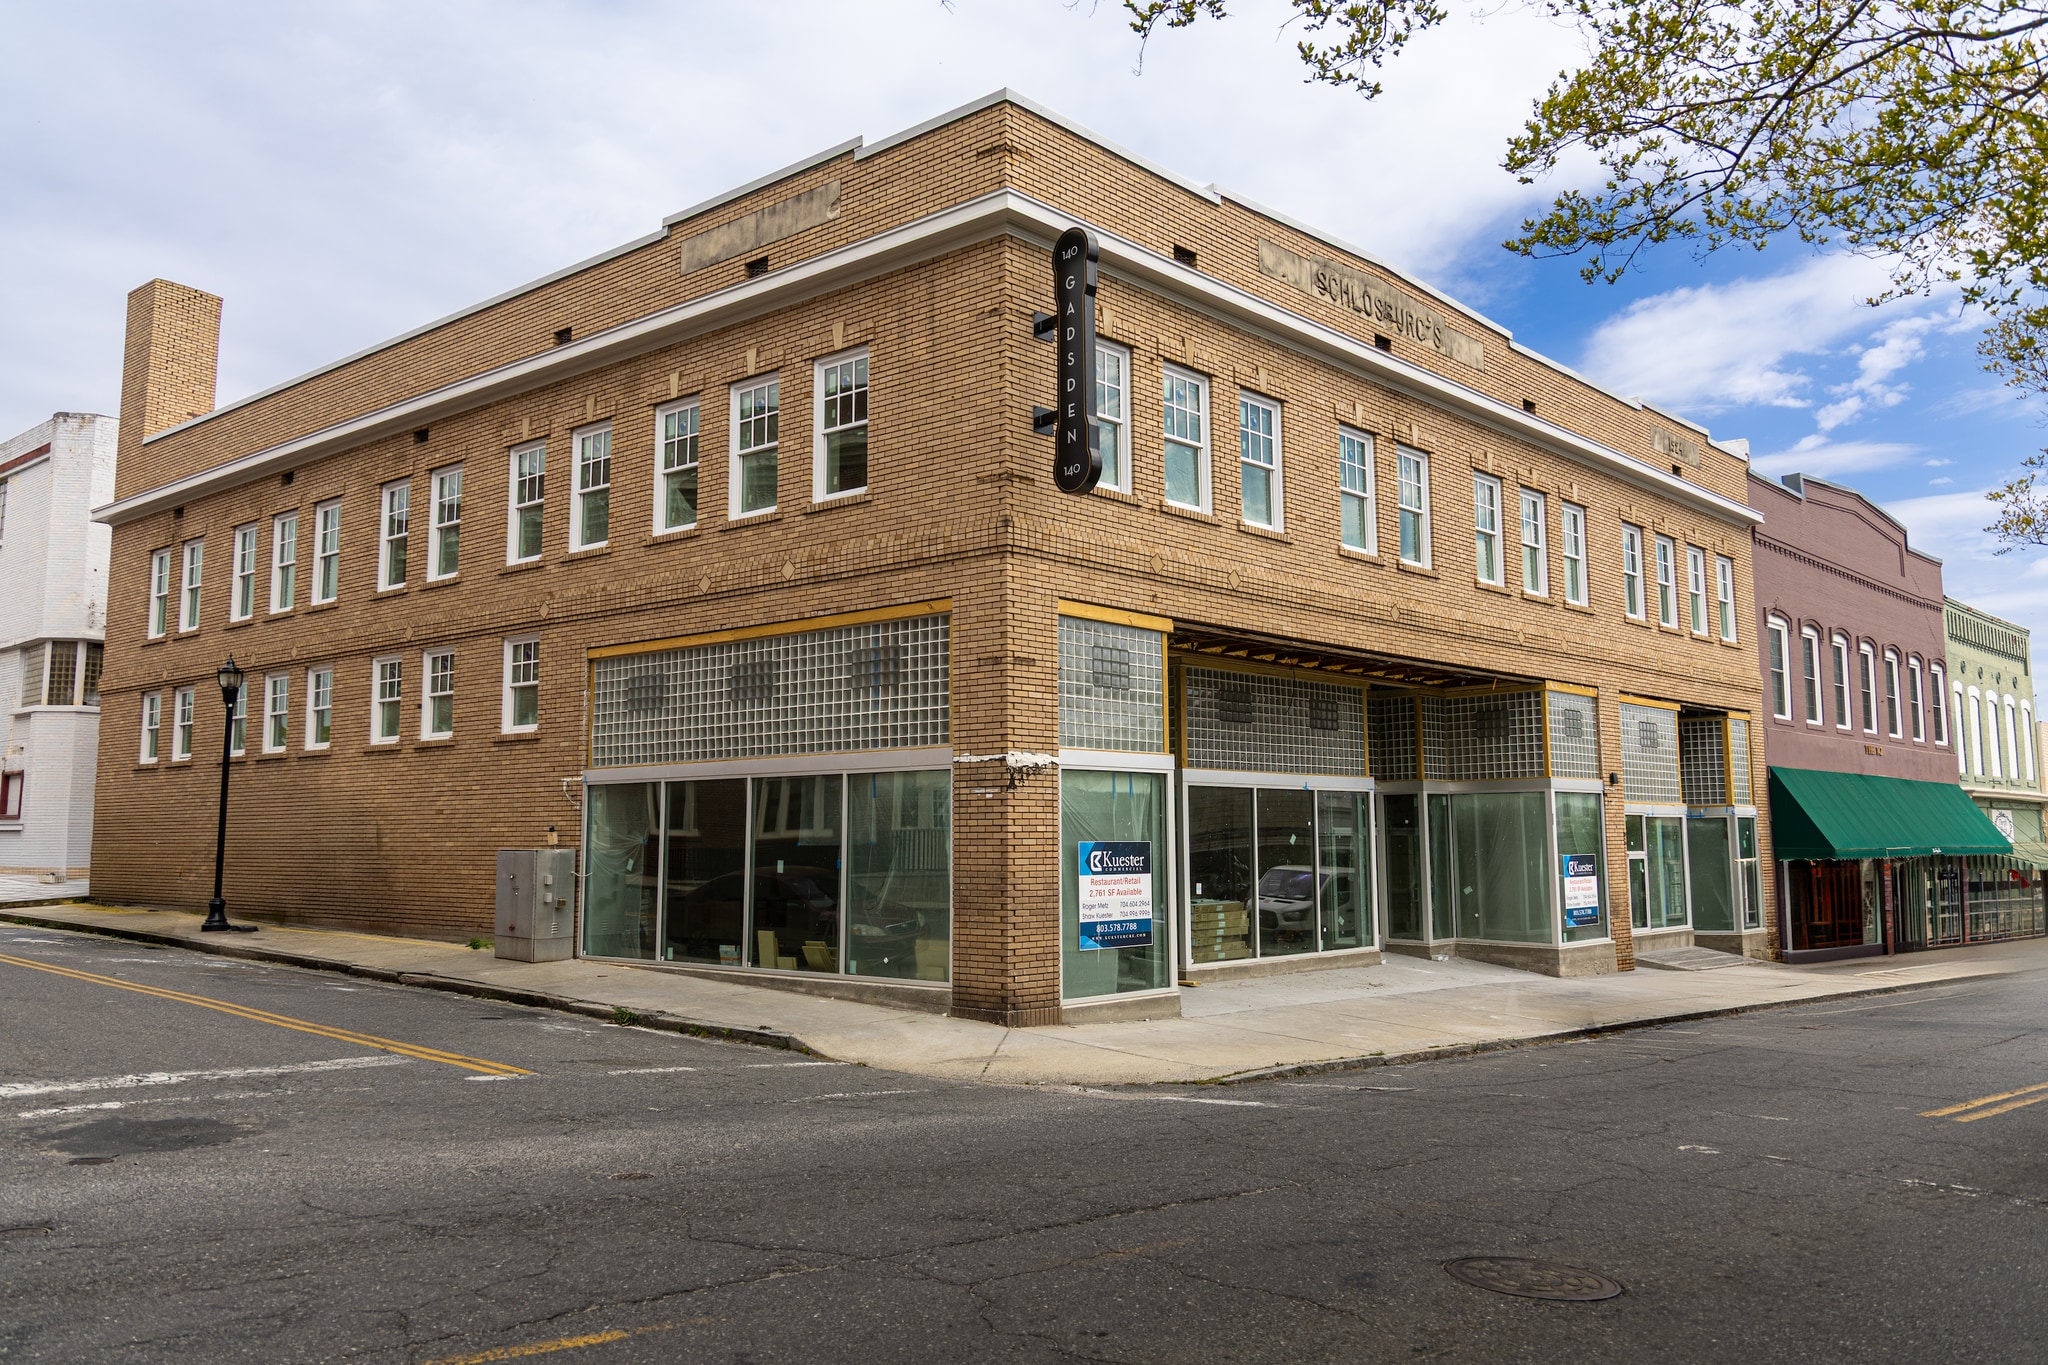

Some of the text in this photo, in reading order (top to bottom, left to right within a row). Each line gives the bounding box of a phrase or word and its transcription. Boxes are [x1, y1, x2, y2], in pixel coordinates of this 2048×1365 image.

[1062, 246, 1078, 260] 140
[1065, 275, 1077, 444] GADSDEN
[1064, 463, 1080, 476] 140
[1103, 851, 1144, 866] Kuester
[1090, 877, 1141, 886] Restaurant/Retail
[1107, 888, 1115, 897] SF
[1116, 888, 1142, 896] Available
